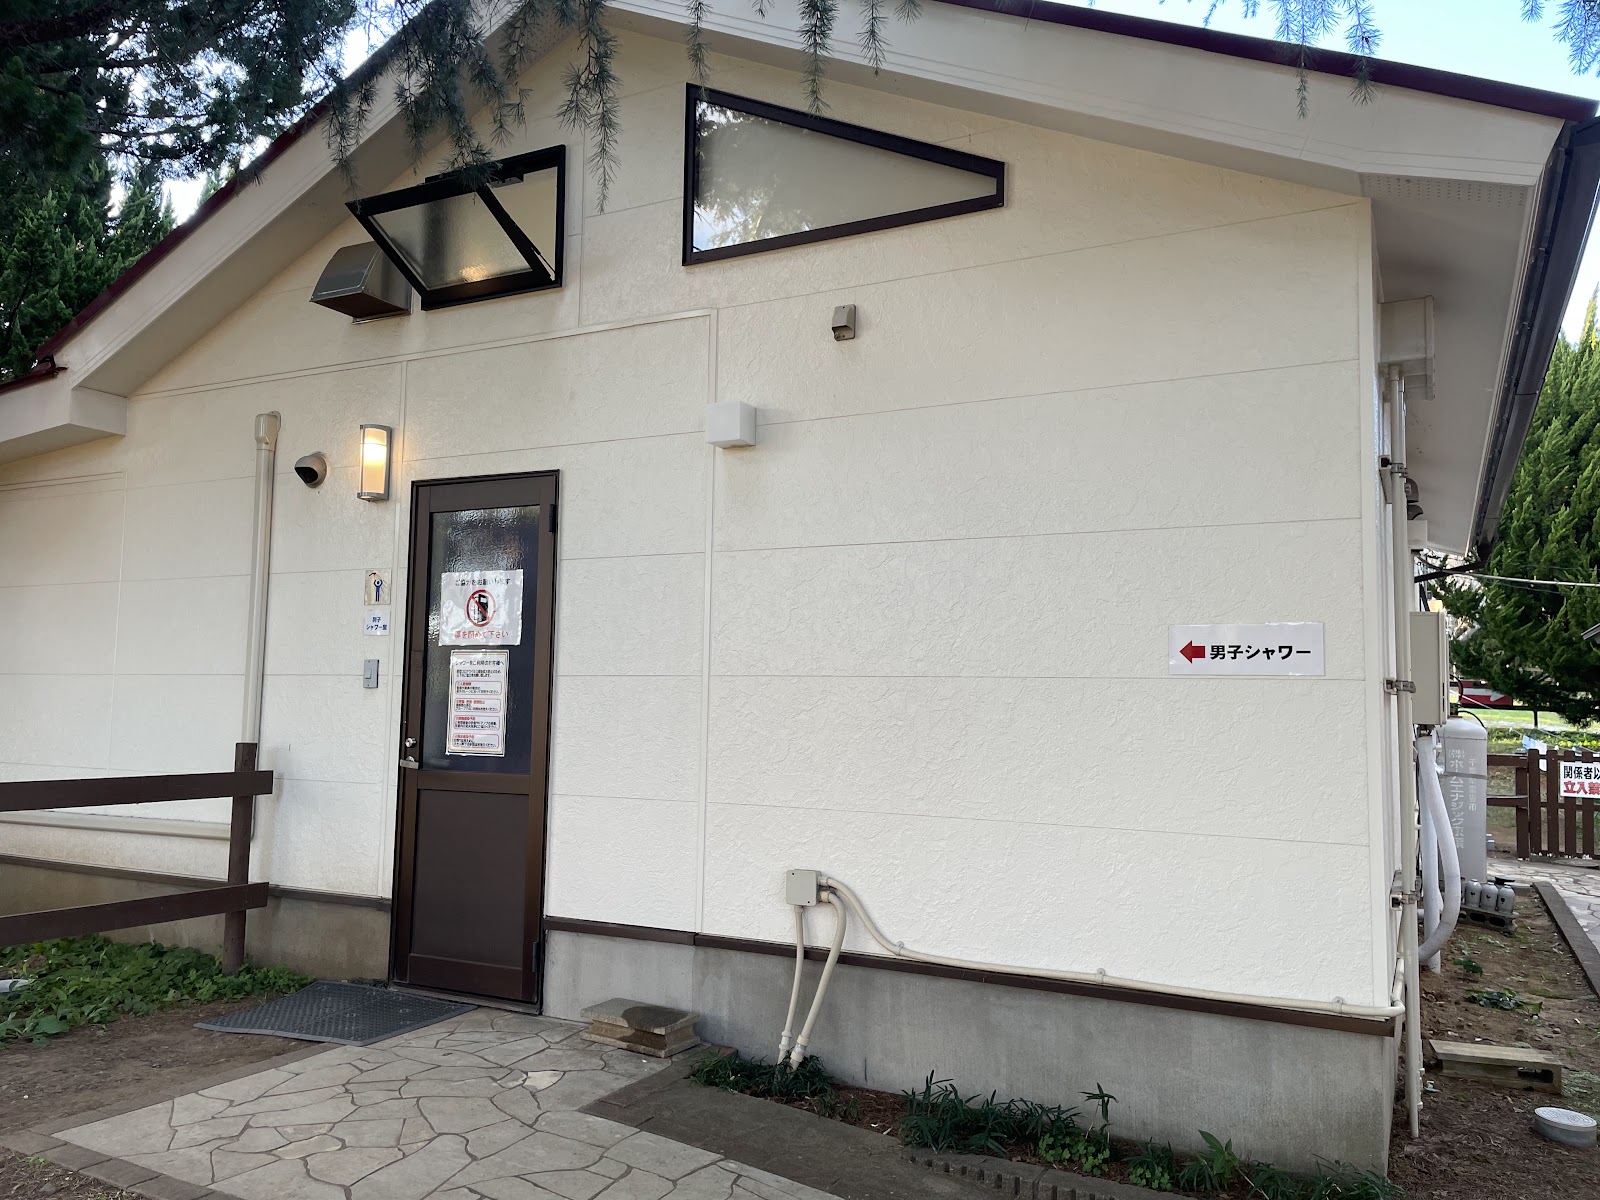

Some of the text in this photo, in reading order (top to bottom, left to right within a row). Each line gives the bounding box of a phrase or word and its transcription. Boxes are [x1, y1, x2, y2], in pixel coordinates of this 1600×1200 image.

[1210, 645, 1311, 660] 男子シャワー
[1564, 766, 1600, 780] 関係者以
